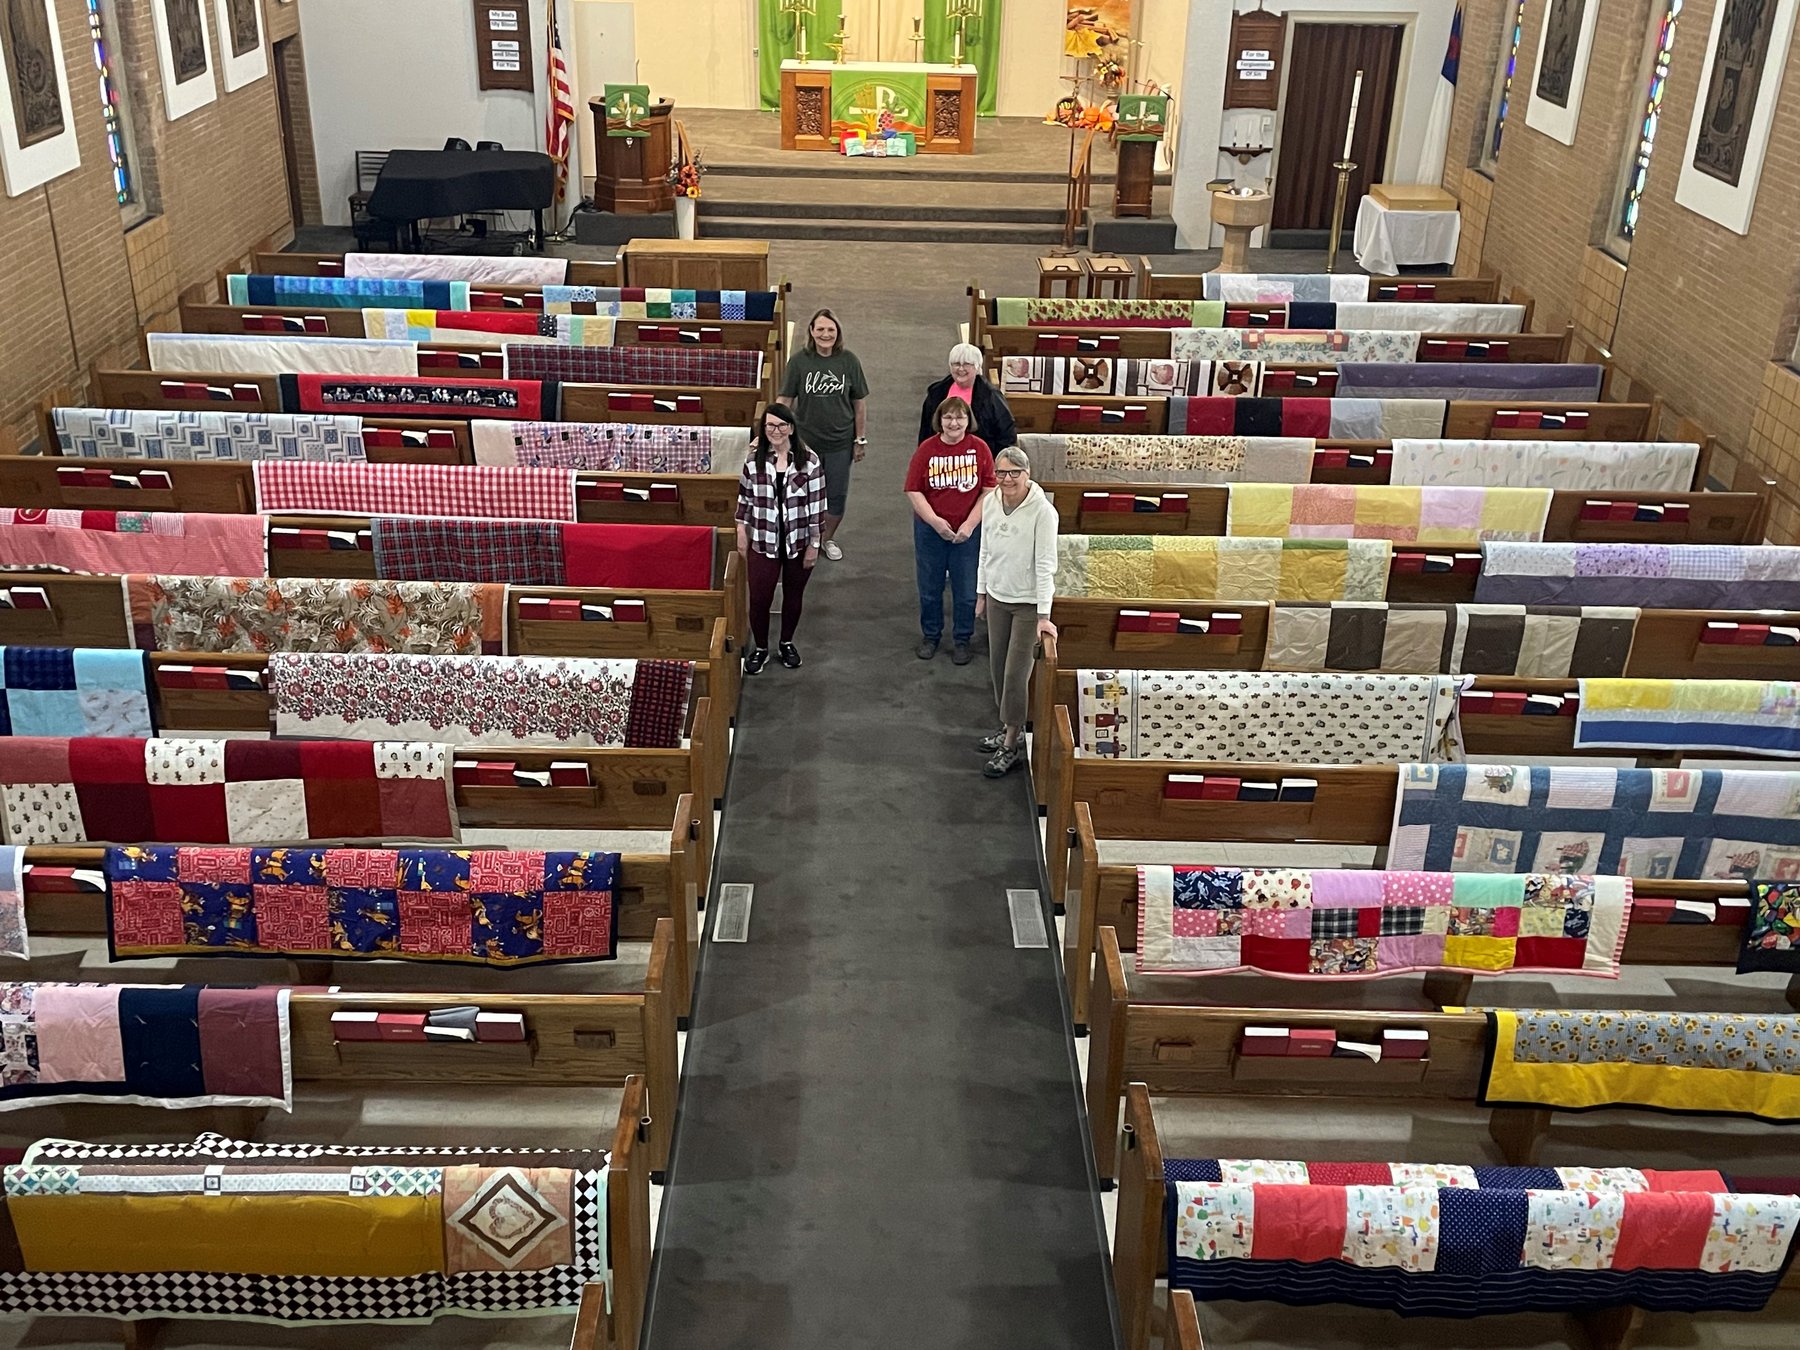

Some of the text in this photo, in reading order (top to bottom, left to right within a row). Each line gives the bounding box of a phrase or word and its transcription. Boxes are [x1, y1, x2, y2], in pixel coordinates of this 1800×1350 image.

[805, 371, 845, 394] blessed
[928, 454, 977, 477] SUPER BOWL
[928, 465, 978, 487] CHAMPIONS
